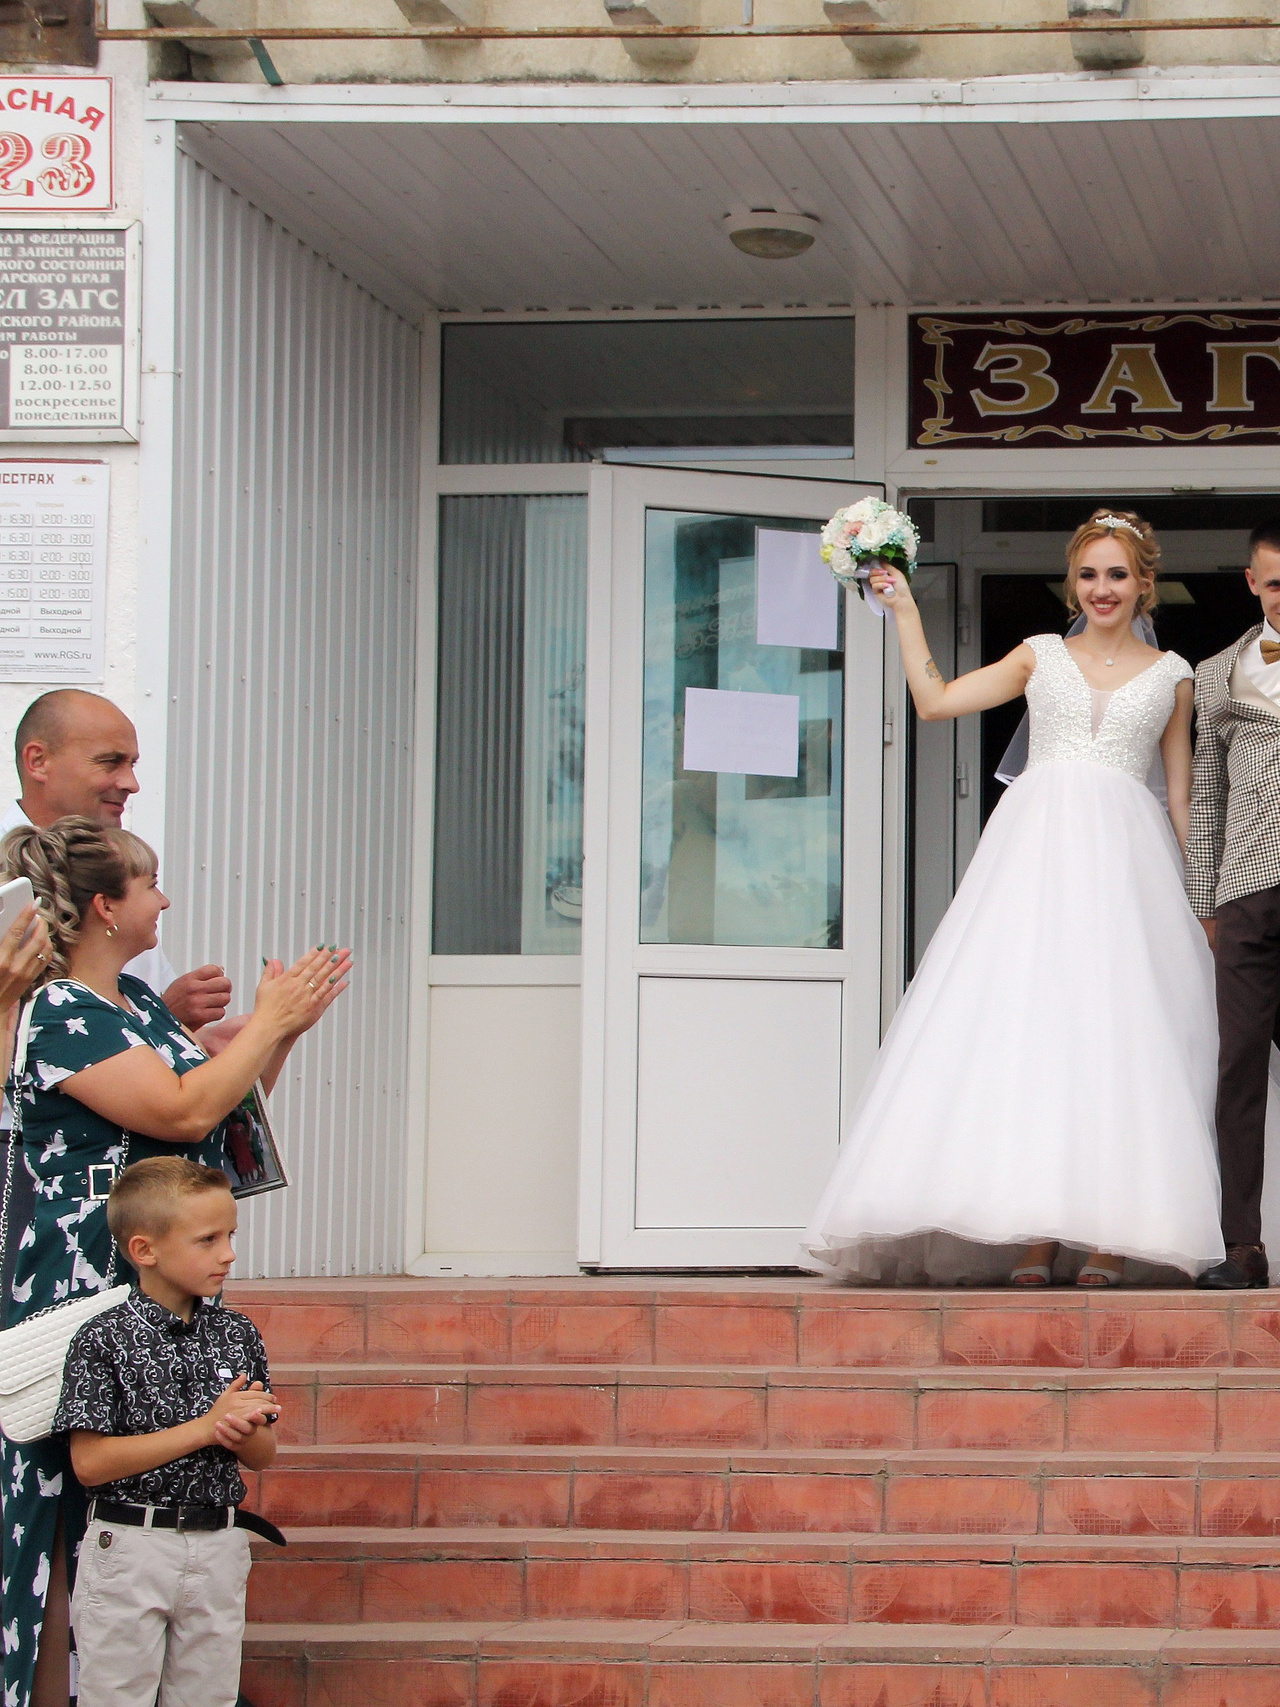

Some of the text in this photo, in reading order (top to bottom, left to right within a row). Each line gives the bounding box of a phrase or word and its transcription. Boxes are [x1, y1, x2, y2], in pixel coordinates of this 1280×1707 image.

[0, 88, 105, 131] СНАЯ
[29, 233, 116, 245] ФЕДЕРАЦИЯ
[17, 247, 74, 257] ЗАПИСИ
[79, 247, 125, 257] АКТОВ
[40, 260, 125, 270] СОСТОЯНИЯ
[71, 273, 110, 283] КРАЯ
[37, 288, 119, 309] ЗАГС
[58, 315, 122, 327] РАЙОНА
[22, 332, 77, 341] РАБОТЫ
[24, 348, 108, 358] 8.00-17.00
[24, 364, 108, 375] 8.00-16.00
[20, 380, 111, 390] 12.00-12.50
[15, 398, 116, 409] воскресенье
[15, 412, 117, 421] понедельник
[0, 473, 54, 484] ССТРАХ
[40, 607, 82, 616] Выходной
[40, 626, 82, 634] Выходной
[34, 651, 92, 660] www.RGS.ru
